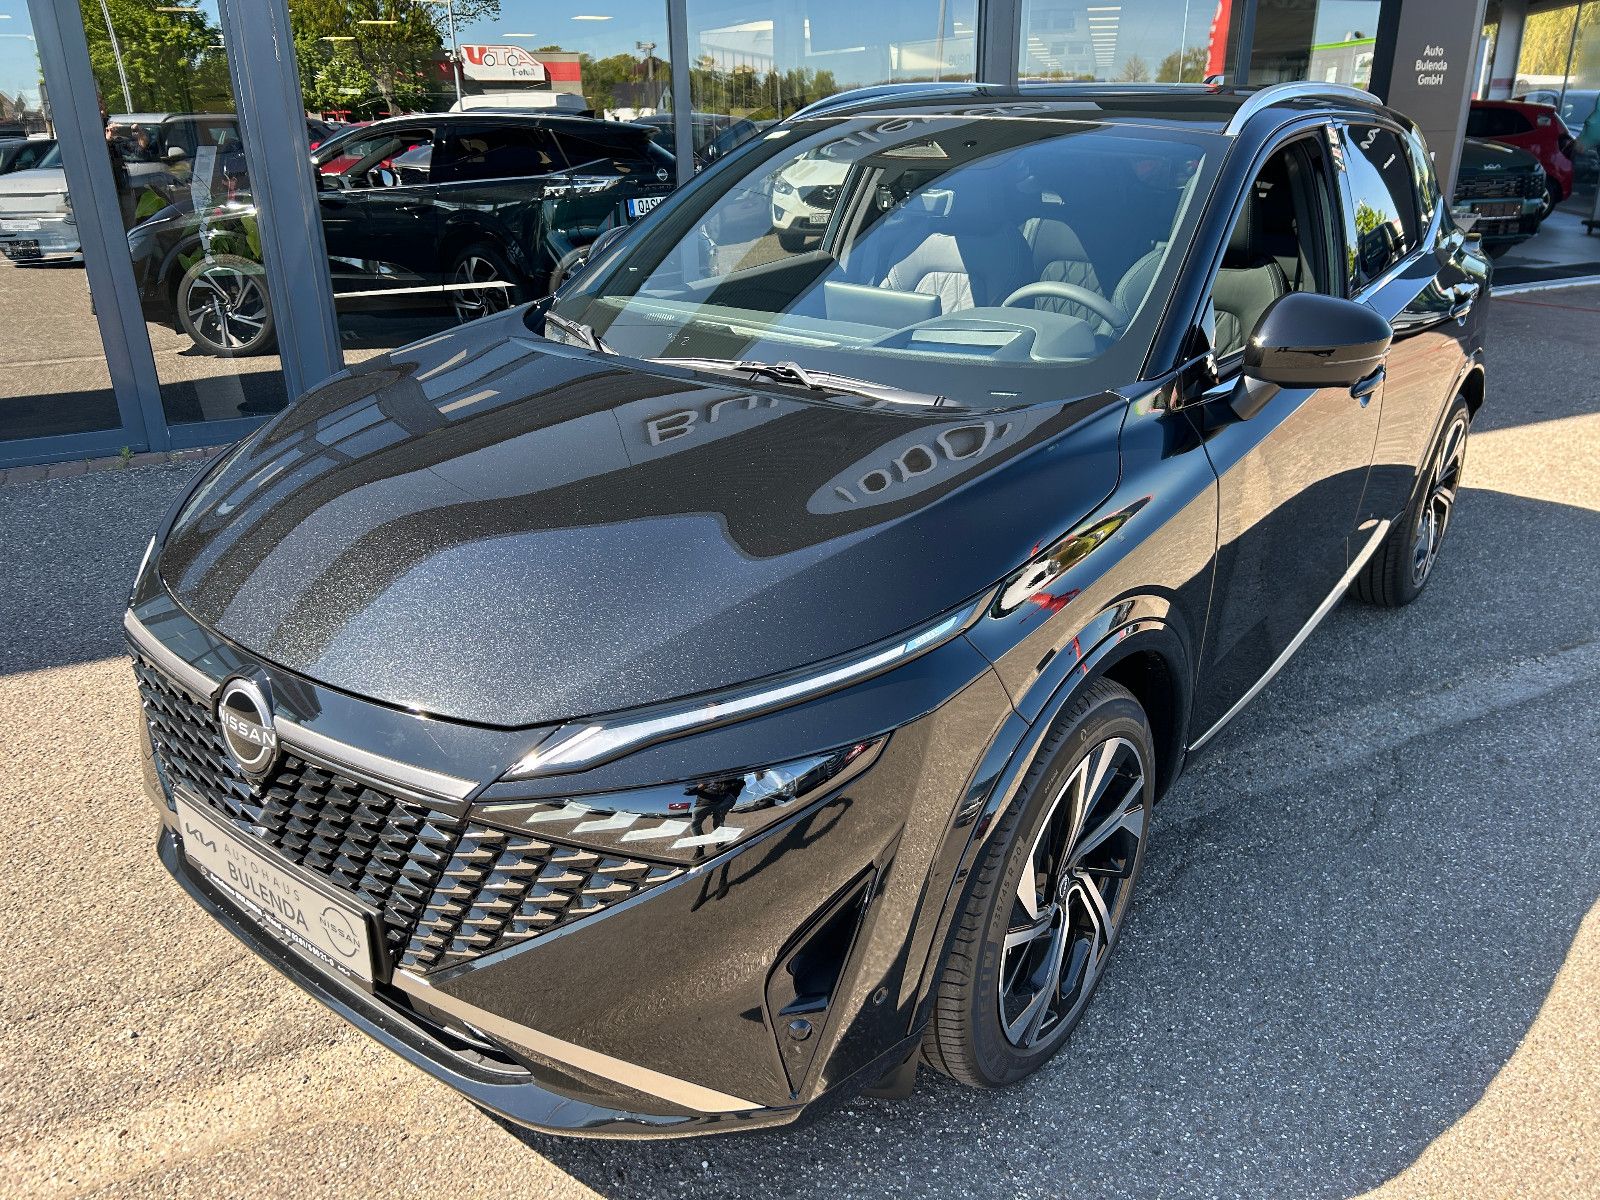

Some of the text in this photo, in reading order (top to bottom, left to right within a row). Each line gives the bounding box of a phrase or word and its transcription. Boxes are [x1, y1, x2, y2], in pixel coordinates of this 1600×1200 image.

[1415, 59, 1448, 71] Bulenda
[1423, 44, 1444, 56] Auto
[1418, 73, 1444, 85] GmbH
[219, 704, 277, 748] NISSAN
[224, 843, 300, 901] AUTOHAUS
[992, 847, 1022, 929] 235/45 R 20
[228, 860, 310, 932] BULENDA
[319, 916, 361, 949] NISSAN
